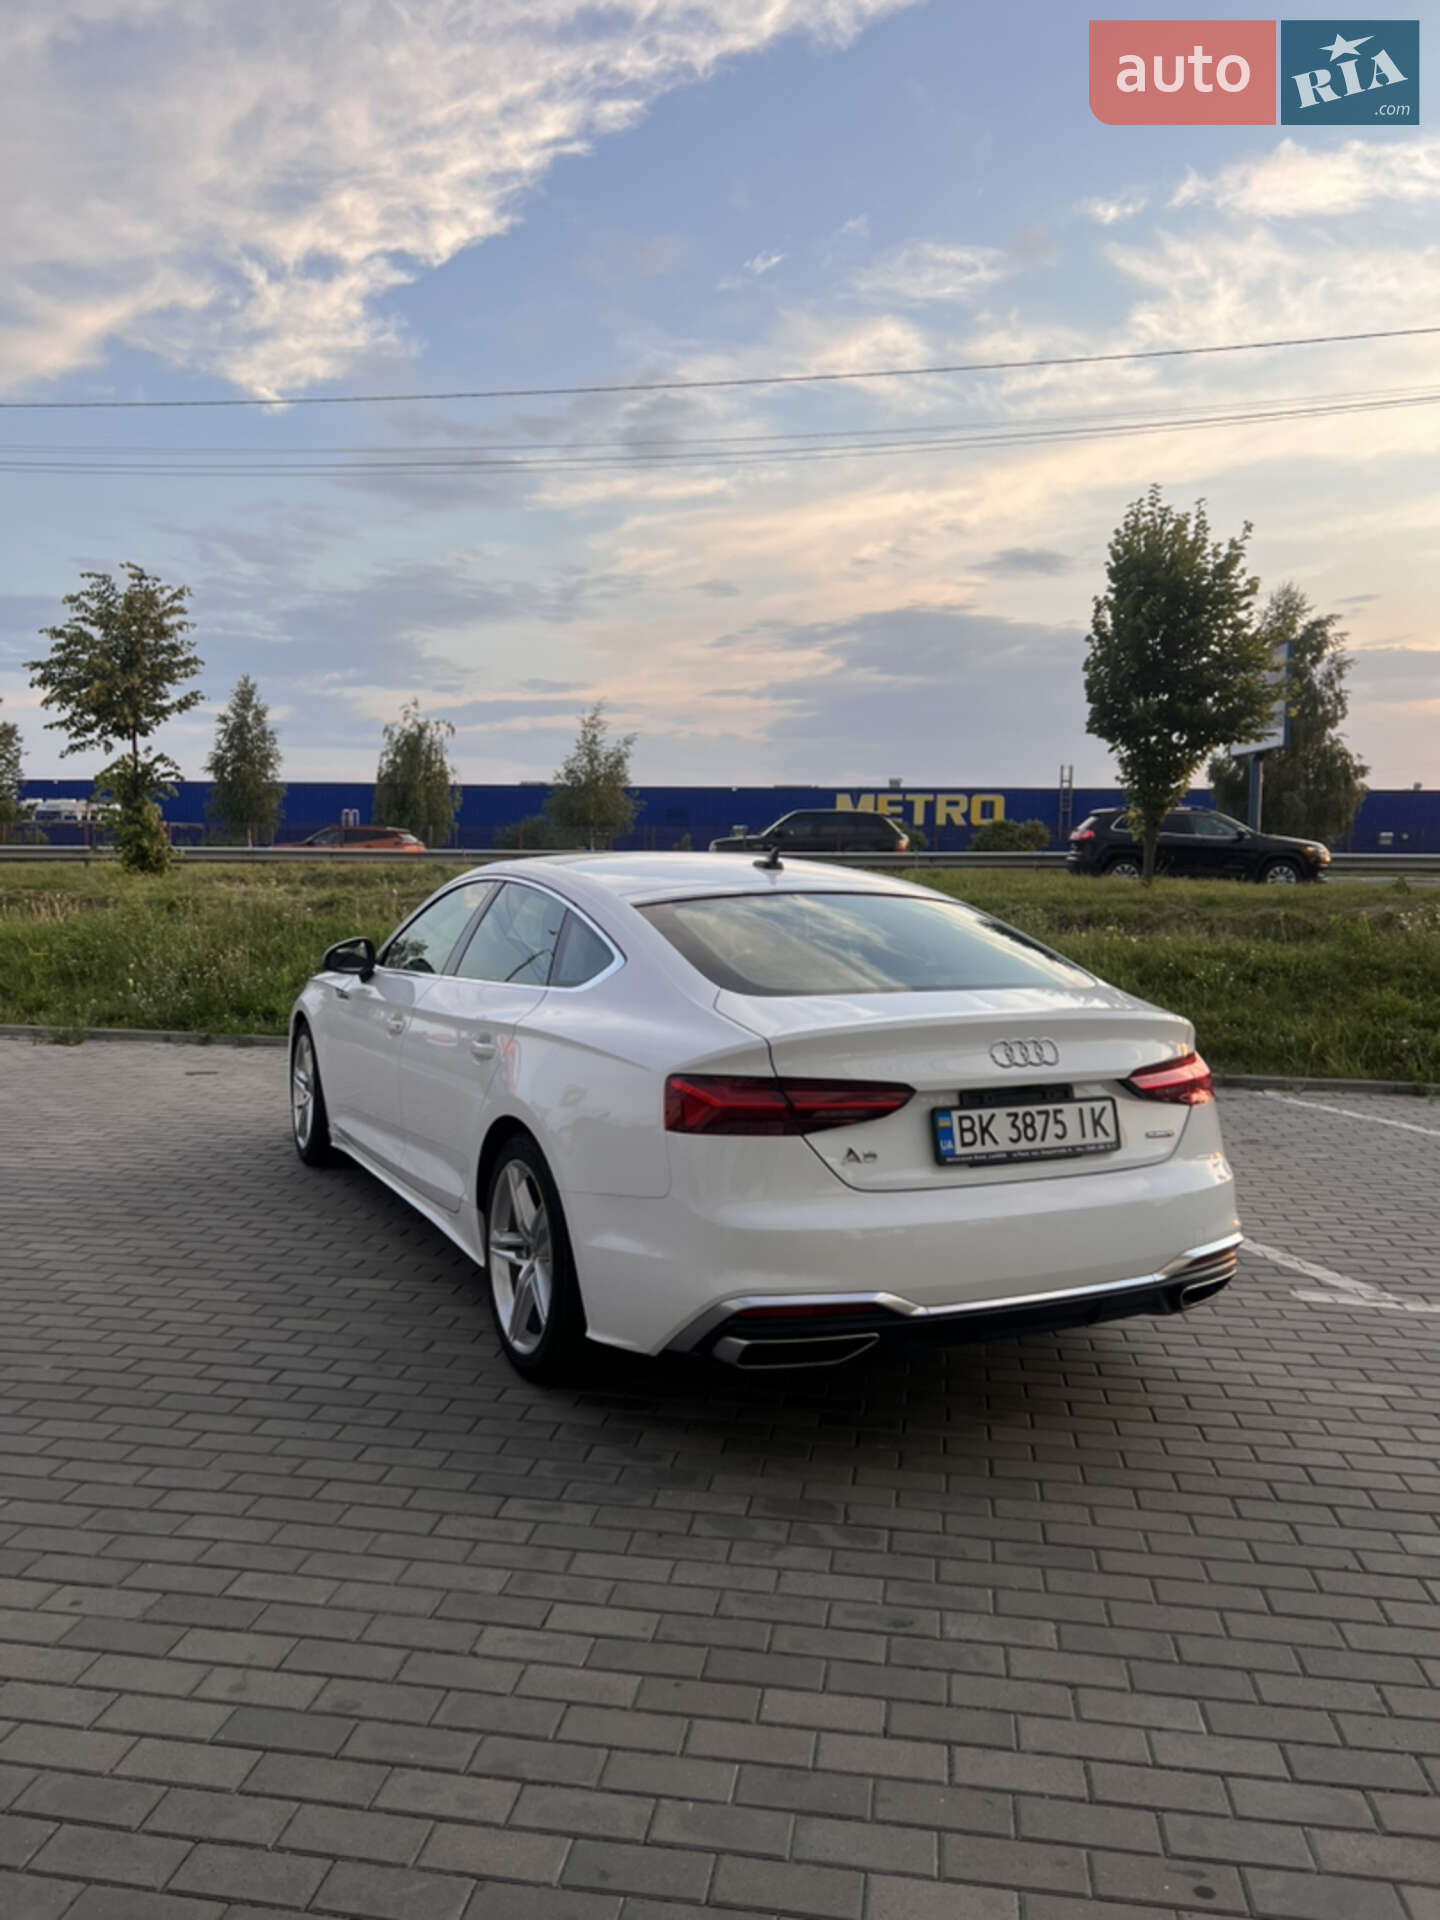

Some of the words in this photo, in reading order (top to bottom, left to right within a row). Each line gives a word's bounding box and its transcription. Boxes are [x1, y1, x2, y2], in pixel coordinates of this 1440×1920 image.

[836, 793, 1005, 827] METRO
[959, 1113, 999, 1147] BK
[1006, 1108, 1067, 1144] 3875
[1078, 1105, 1110, 1138] IK
